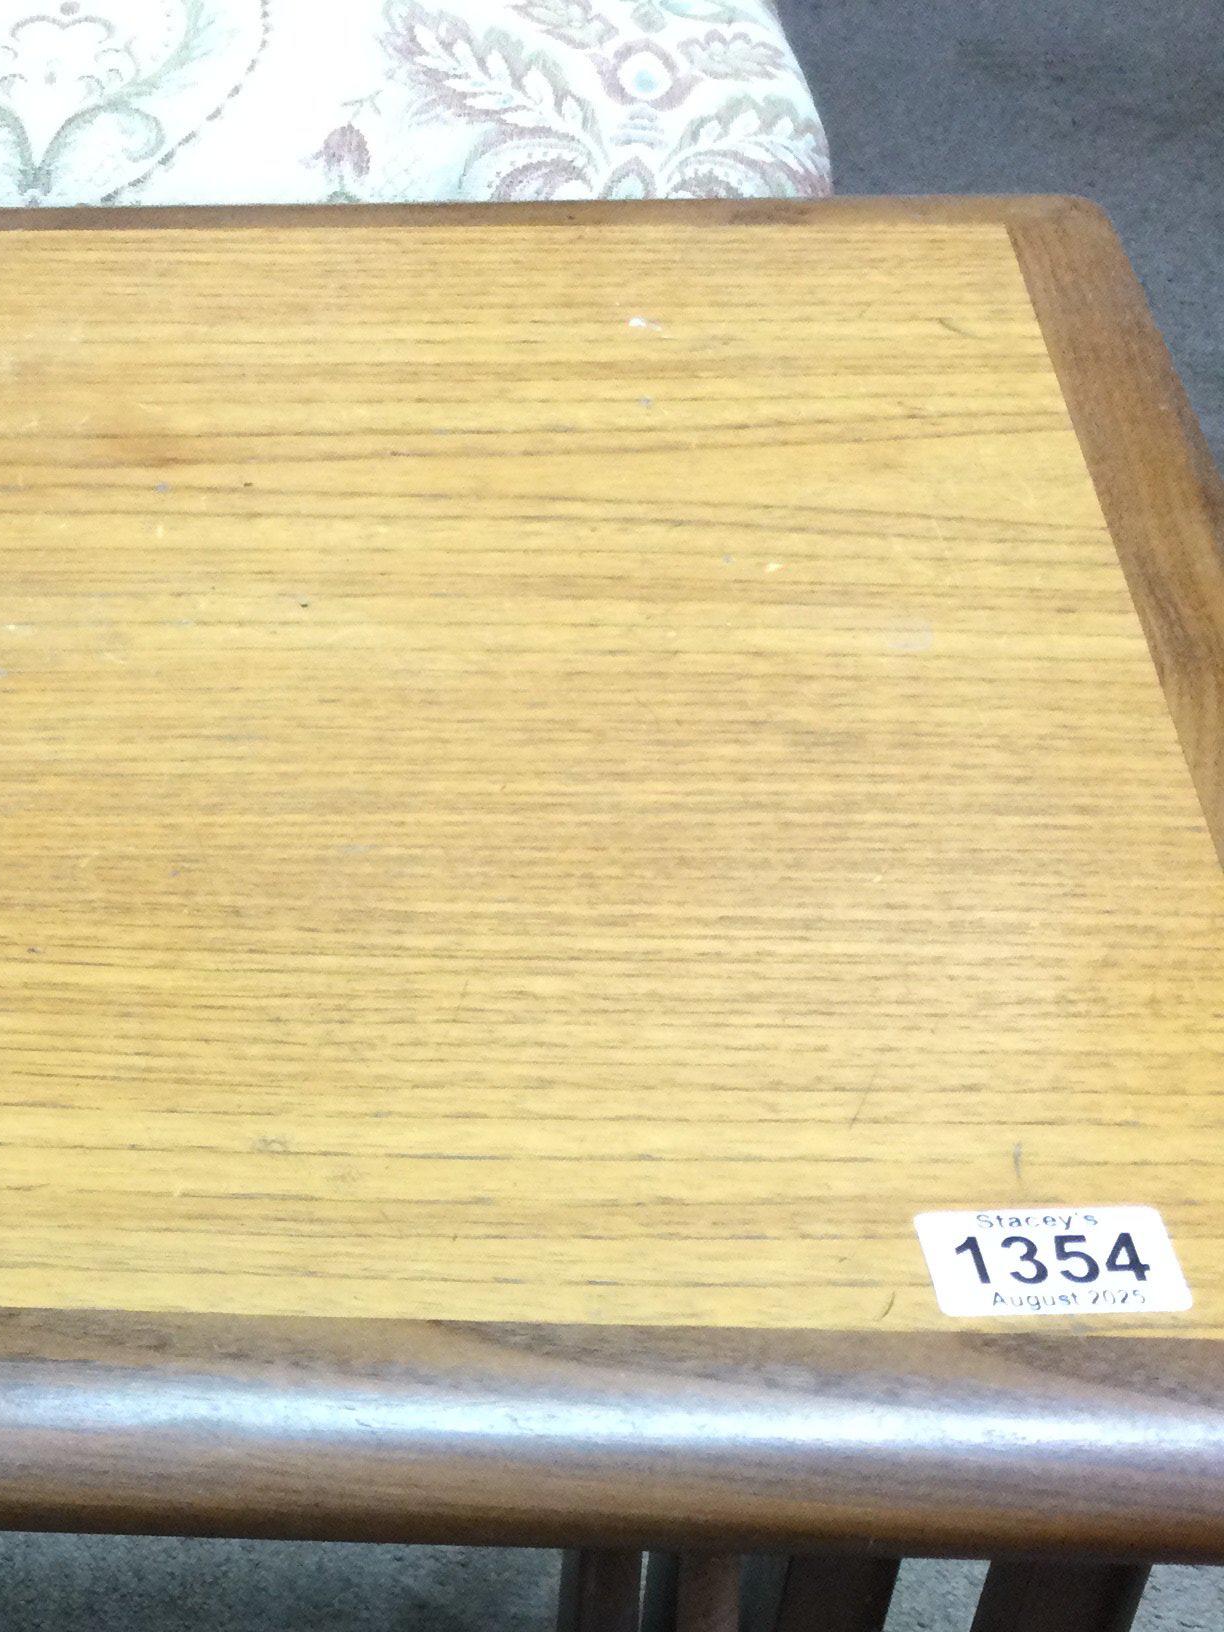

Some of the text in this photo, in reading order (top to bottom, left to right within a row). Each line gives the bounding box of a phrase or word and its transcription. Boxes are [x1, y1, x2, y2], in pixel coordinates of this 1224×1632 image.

[976, 1212, 1098, 1230] Stacey's
[955, 1232, 1150, 1284] 1354
[992, 1289, 1146, 1310] August 2025
